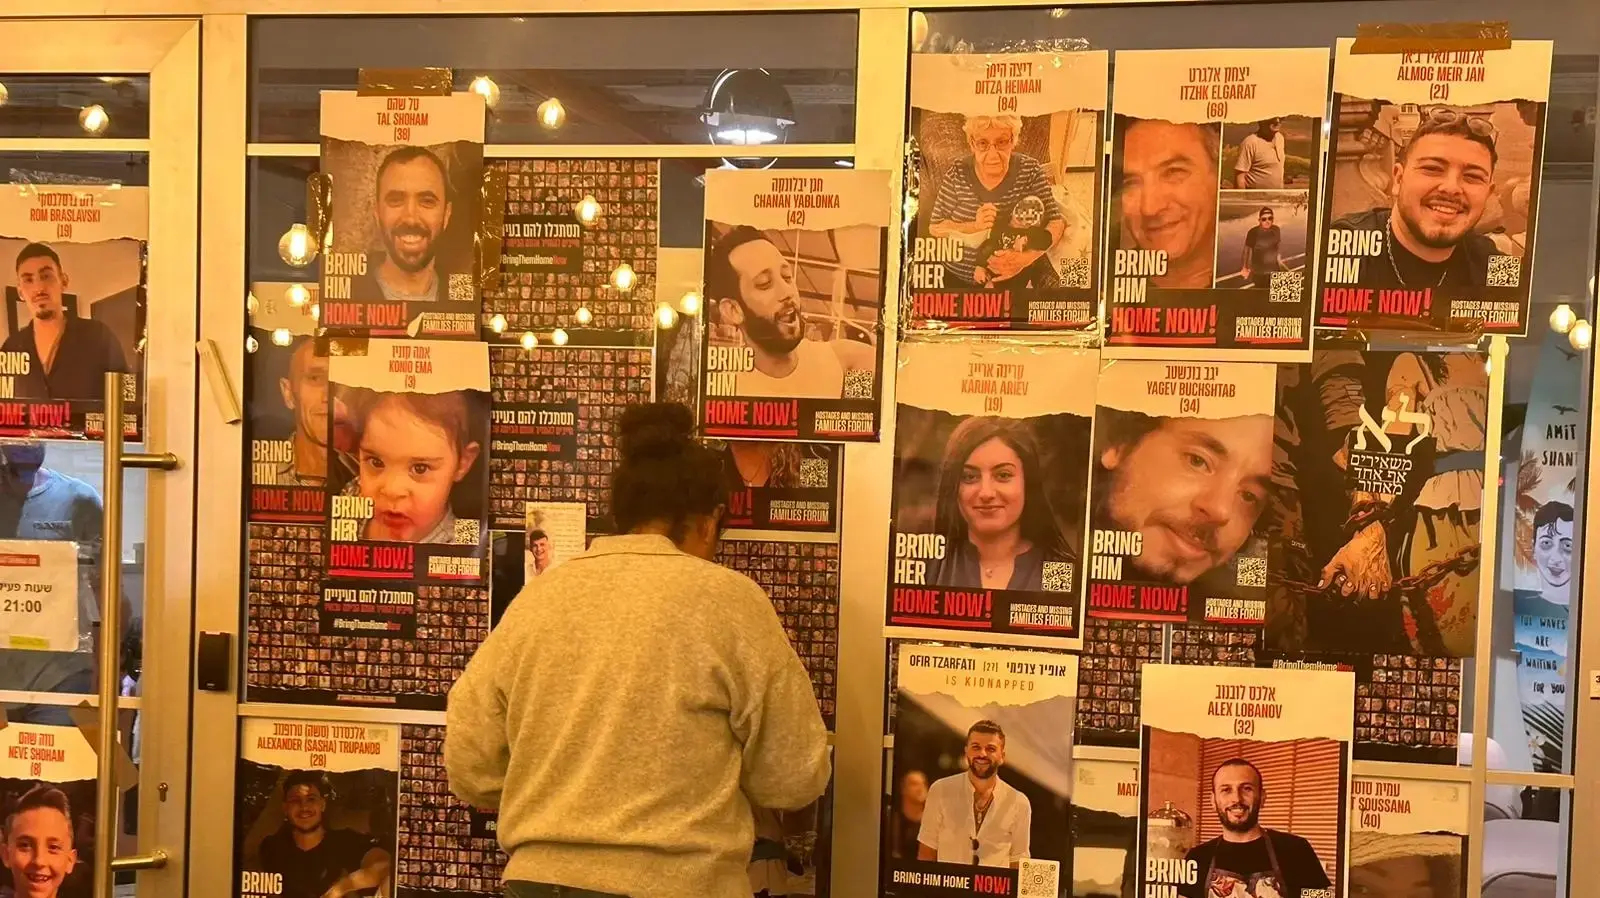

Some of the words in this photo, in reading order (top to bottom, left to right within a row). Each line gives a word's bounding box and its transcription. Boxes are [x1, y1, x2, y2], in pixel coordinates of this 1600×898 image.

[1009, 62, 1032, 77] דיצה
[1189, 66, 1220, 83] אלגרט
[1225, 66, 1250, 83] יצחק
[1397, 66, 1434, 81] ALMOG
[1437, 67, 1462, 81] MEIR
[1465, 67, 1485, 82] JAN
[975, 80, 1002, 94] DITZA
[1005, 79, 1041, 94] HEIMAN
[1180, 85, 1208, 100] ITZHK
[1212, 84, 1257, 99] ELGARAT
[1429, 83, 1449, 101] (21)
[387, 97, 406, 111] שהם
[408, 97, 420, 111] טל
[998, 95, 1017, 112] (84)
[1207, 101, 1227, 119] (68)
[377, 113, 391, 126] TAL
[393, 113, 429, 126] SHOHAM
[394, 127, 411, 142] (38)
[772, 177, 807, 193] יבלונקה
[809, 177, 824, 193] חנן
[753, 193, 791, 209] CHANAN
[793, 194, 840, 209] YABLONKA
[30, 208, 48, 222] ROM
[50, 208, 101, 223] BRASLAVSKI
[787, 210, 806, 227] (42)
[57, 223, 73, 239] (19)
[524, 222, 542, 238] להם
[545, 222, 580, 238] תסתכלו
[914, 237, 963, 263] BRING
[1328, 229, 1382, 256] BRING
[326, 252, 367, 276] BRING
[1115, 249, 1167, 276] BRING
[1325, 257, 1360, 284] HIM
[914, 263, 945, 289] HER
[325, 276, 352, 299] HIM
[1113, 277, 1147, 303] HIM
[913, 293, 959, 319] HOME
[962, 291, 1010, 319] NOW!
[1028, 301, 1055, 310] HOSTAGES
[1056, 302, 1066, 310] AND
[1323, 288, 1374, 314] HOME
[1378, 288, 1432, 316] NOW!
[1451, 300, 1480, 310] HOSTAGES
[1481, 301, 1493, 311] AND
[1493, 302, 1520, 312] MISSING
[325, 302, 364, 325] HOME
[368, 302, 408, 327] NOW!
[1028, 310, 1061, 322] FAMILIES
[1063, 311, 1090, 323] FORUM
[1112, 307, 1161, 333] HOME
[1165, 304, 1217, 334] NOW!
[1236, 316, 1264, 326] HOSTAGES
[1265, 317, 1277, 326] AND
[1277, 317, 1302, 327] MISSING
[1488, 312, 1519, 325] FORUM
[1235, 326, 1271, 339] FAMILIES
[1273, 327, 1302, 339] FORUM
[389, 360, 413, 373] KONIO
[415, 361, 433, 374] EMA
[708, 346, 754, 372] BRING
[997, 364, 1024, 380] קרינה
[1165, 365, 1201, 380] בוכשטב
[1203, 366, 1219, 381] יגב
[405, 375, 416, 389] (3)
[706, 372, 738, 397] HIM
[961, 379, 997, 395] KARINA
[999, 381, 1029, 396] ARIEV
[1147, 381, 1177, 396] YAGEV
[1179, 382, 1236, 398] BUCHSHTAB
[984, 396, 1003, 413] (19)
[1180, 397, 1200, 414] (34)
[30, 401, 71, 428] NOW!
[518, 410, 537, 424] להם
[540, 411, 575, 425] תסתכלו
[706, 400, 748, 425] HOME
[753, 400, 798, 427] NOW!
[815, 411, 841, 421] HOSTAGES
[815, 420, 847, 433] FAMILIES
[847, 421, 874, 433] FORUM
[1354, 392, 1431, 455] לא
[252, 440, 293, 463] BRING
[1350, 453, 1413, 471] משאירים
[252, 462, 278, 485] HIM
[1354, 466, 1383, 481] אחד
[1387, 469, 1407, 486] אף
[1358, 479, 1403, 496] מאחור
[252, 489, 289, 511] HOME
[332, 495, 374, 519] BRING
[770, 509, 802, 521] FAMILIES
[803, 510, 829, 522] FORUM
[331, 519, 358, 542] HER
[896, 532, 946, 560] BRING
[1093, 529, 1143, 556] BRING
[330, 545, 370, 568] HOME
[373, 545, 414, 570] NOW!
[894, 559, 926, 585] HER
[1091, 555, 1123, 581] HIM
[25, 583, 53, 593] שעות
[359, 589, 377, 603] להם
[4, 599, 42, 613] 21:00
[380, 590, 414, 605] תסתכלו
[893, 588, 939, 614] HOME
[944, 590, 992, 618] NOW!
[1090, 584, 1136, 609] HOME
[1140, 586, 1188, 612] NOW!
[1010, 603, 1037, 613] HOSTAGES
[1205, 606, 1239, 619] FAMILIES
[1240, 607, 1266, 621] FORUM
[1010, 612, 1044, 626] FAMILIES
[1044, 614, 1073, 628] FORUM
[909, 655, 930, 667] OFIR
[932, 656, 976, 670] TZARFATI
[1006, 662, 1036, 675] צרפתי
[1039, 664, 1067, 677] אופיר
[946, 675, 957, 686] IS
[964, 676, 1035, 691] KIDNAPPED
[1215, 684, 1246, 700] לובנוב
[1249, 685, 1276, 701] אלכס
[1207, 701, 1233, 716] ALEX
[1235, 703, 1283, 719] LOBANOV
[1233, 718, 1255, 736] (32)
[9, 746, 28, 760] NEVE
[30, 747, 65, 762] SHOHAM
[257, 737, 303, 752] ALEXANDER
[305, 739, 337, 754] (SASHA)
[339, 740, 381, 755] TRUPANOB
[310, 753, 327, 768] (28)
[30, 763, 42, 777] (8)
[1376, 782, 1401, 797] עמית
[1358, 797, 1411, 814] SOUSSANA
[1361, 810, 1381, 829] (40)
[1145, 857, 1198, 885] BRING
[242, 871, 283, 895] BRING
[893, 870, 921, 885] BRING
[922, 872, 941, 887] HIM
[943, 874, 970, 890] HOME
[974, 875, 1011, 895] NOW!
